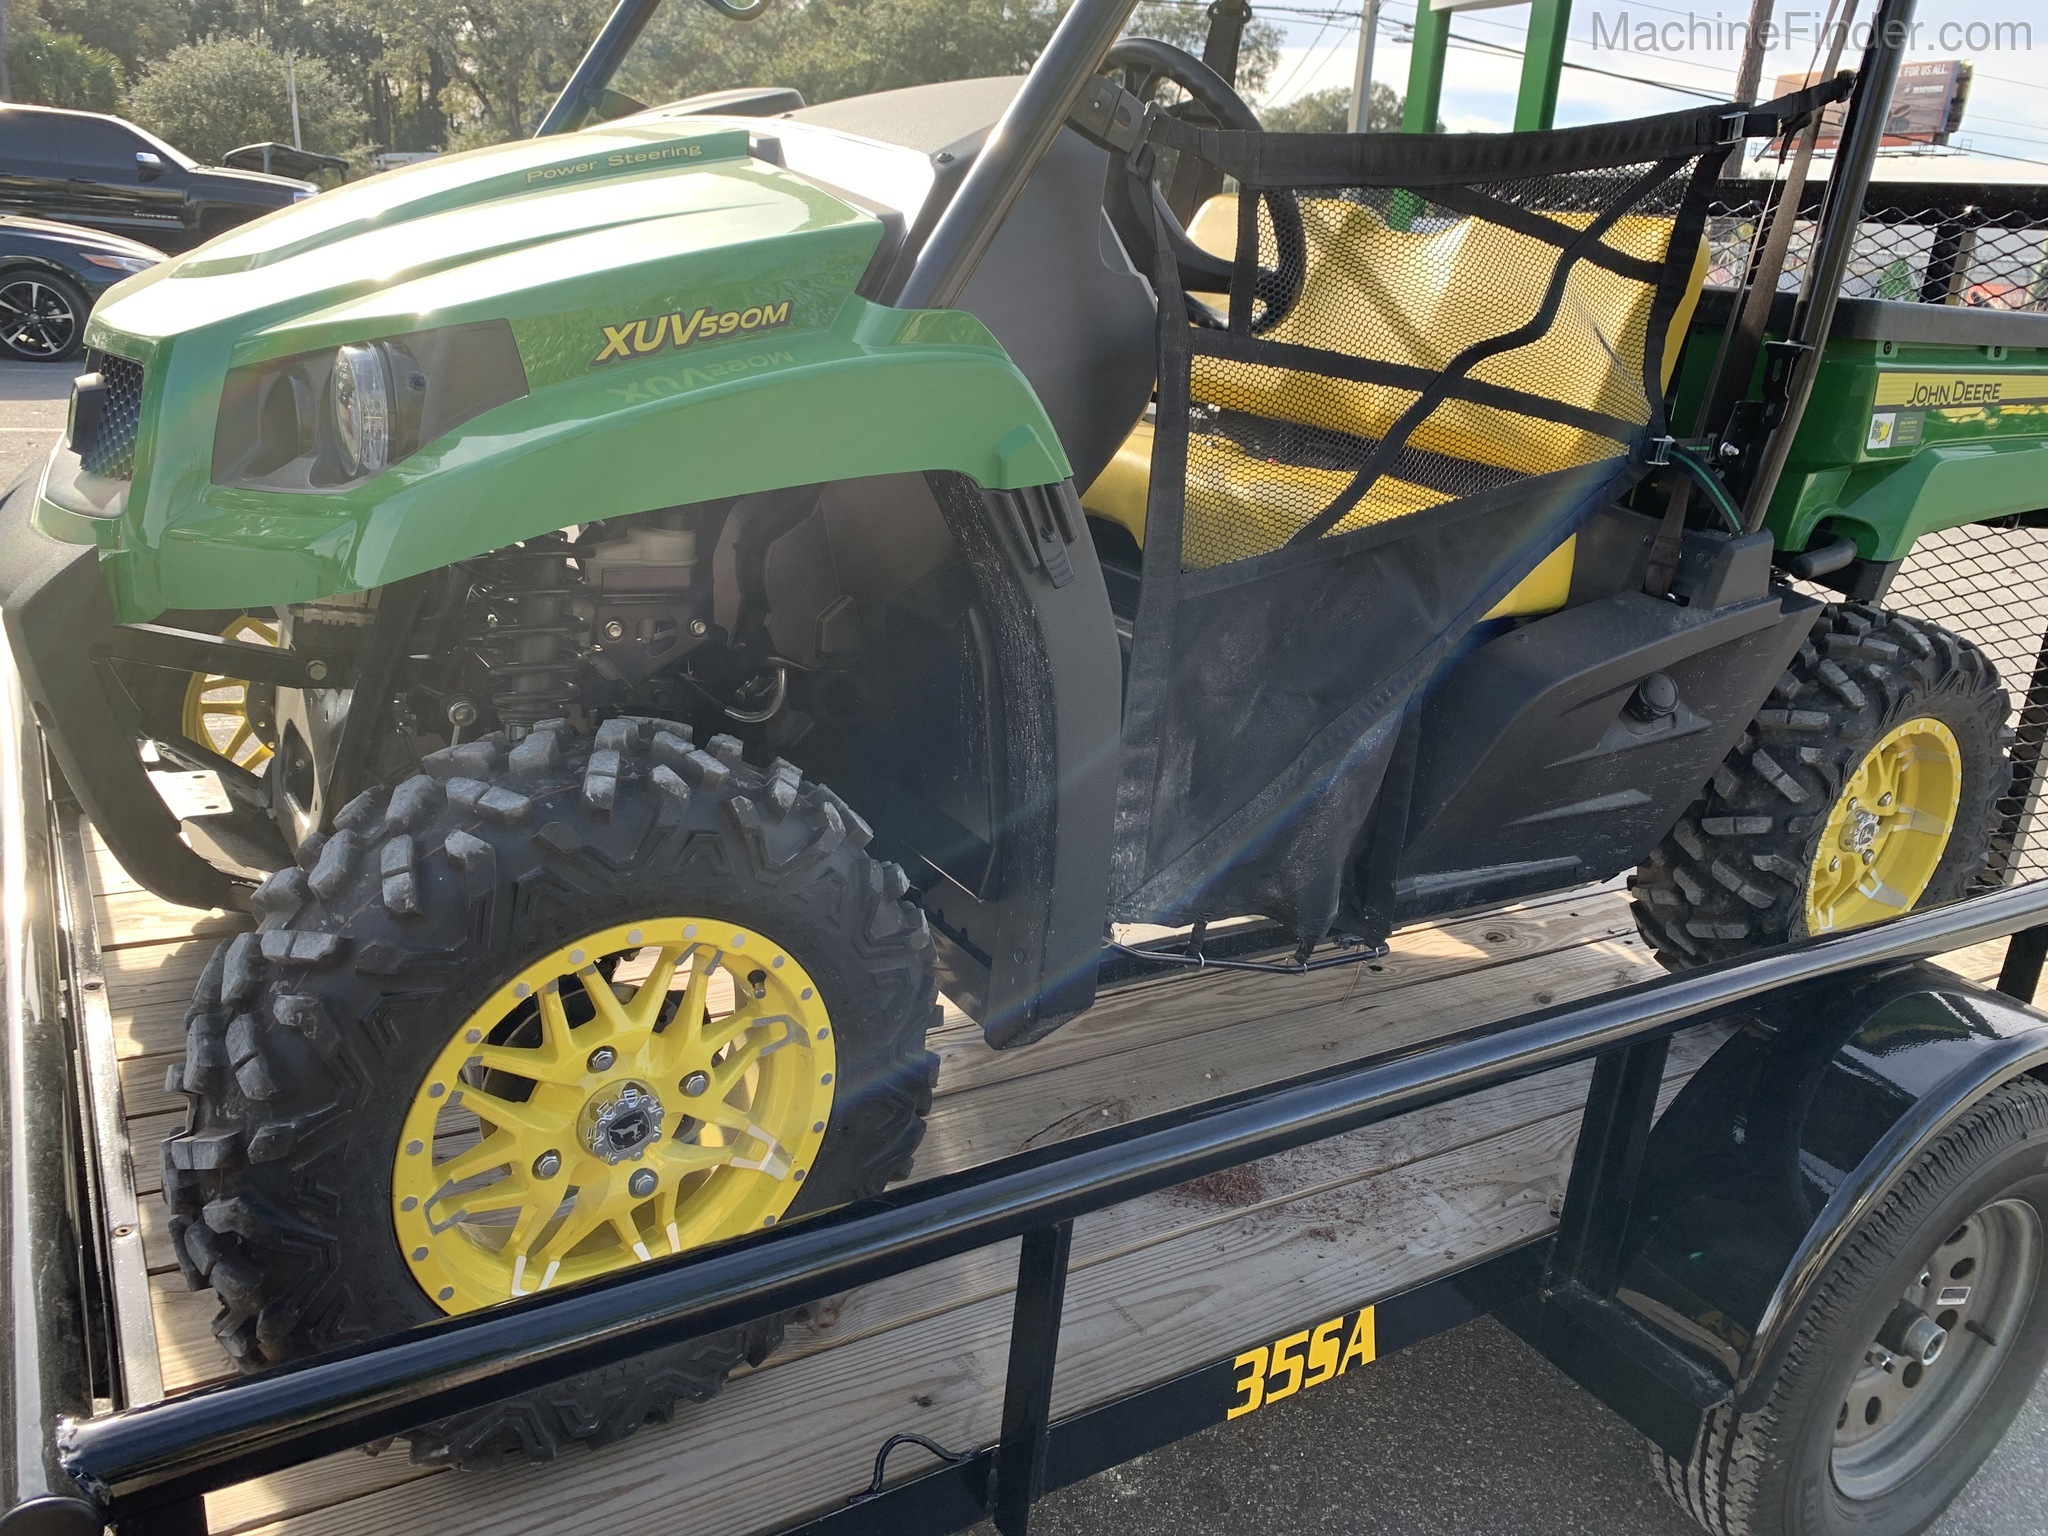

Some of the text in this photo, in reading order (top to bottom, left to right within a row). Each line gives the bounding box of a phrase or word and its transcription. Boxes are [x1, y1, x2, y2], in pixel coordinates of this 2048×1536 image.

[1904, 65, 1920, 77] FOR
[1920, 65, 1932, 76] US
[526, 144, 703, 184] Power Steering
[592, 300, 790, 363] XUV590M
[1906, 380, 2002, 404] JOHN DEERE
[1226, 1304, 1377, 1421] 35SA
